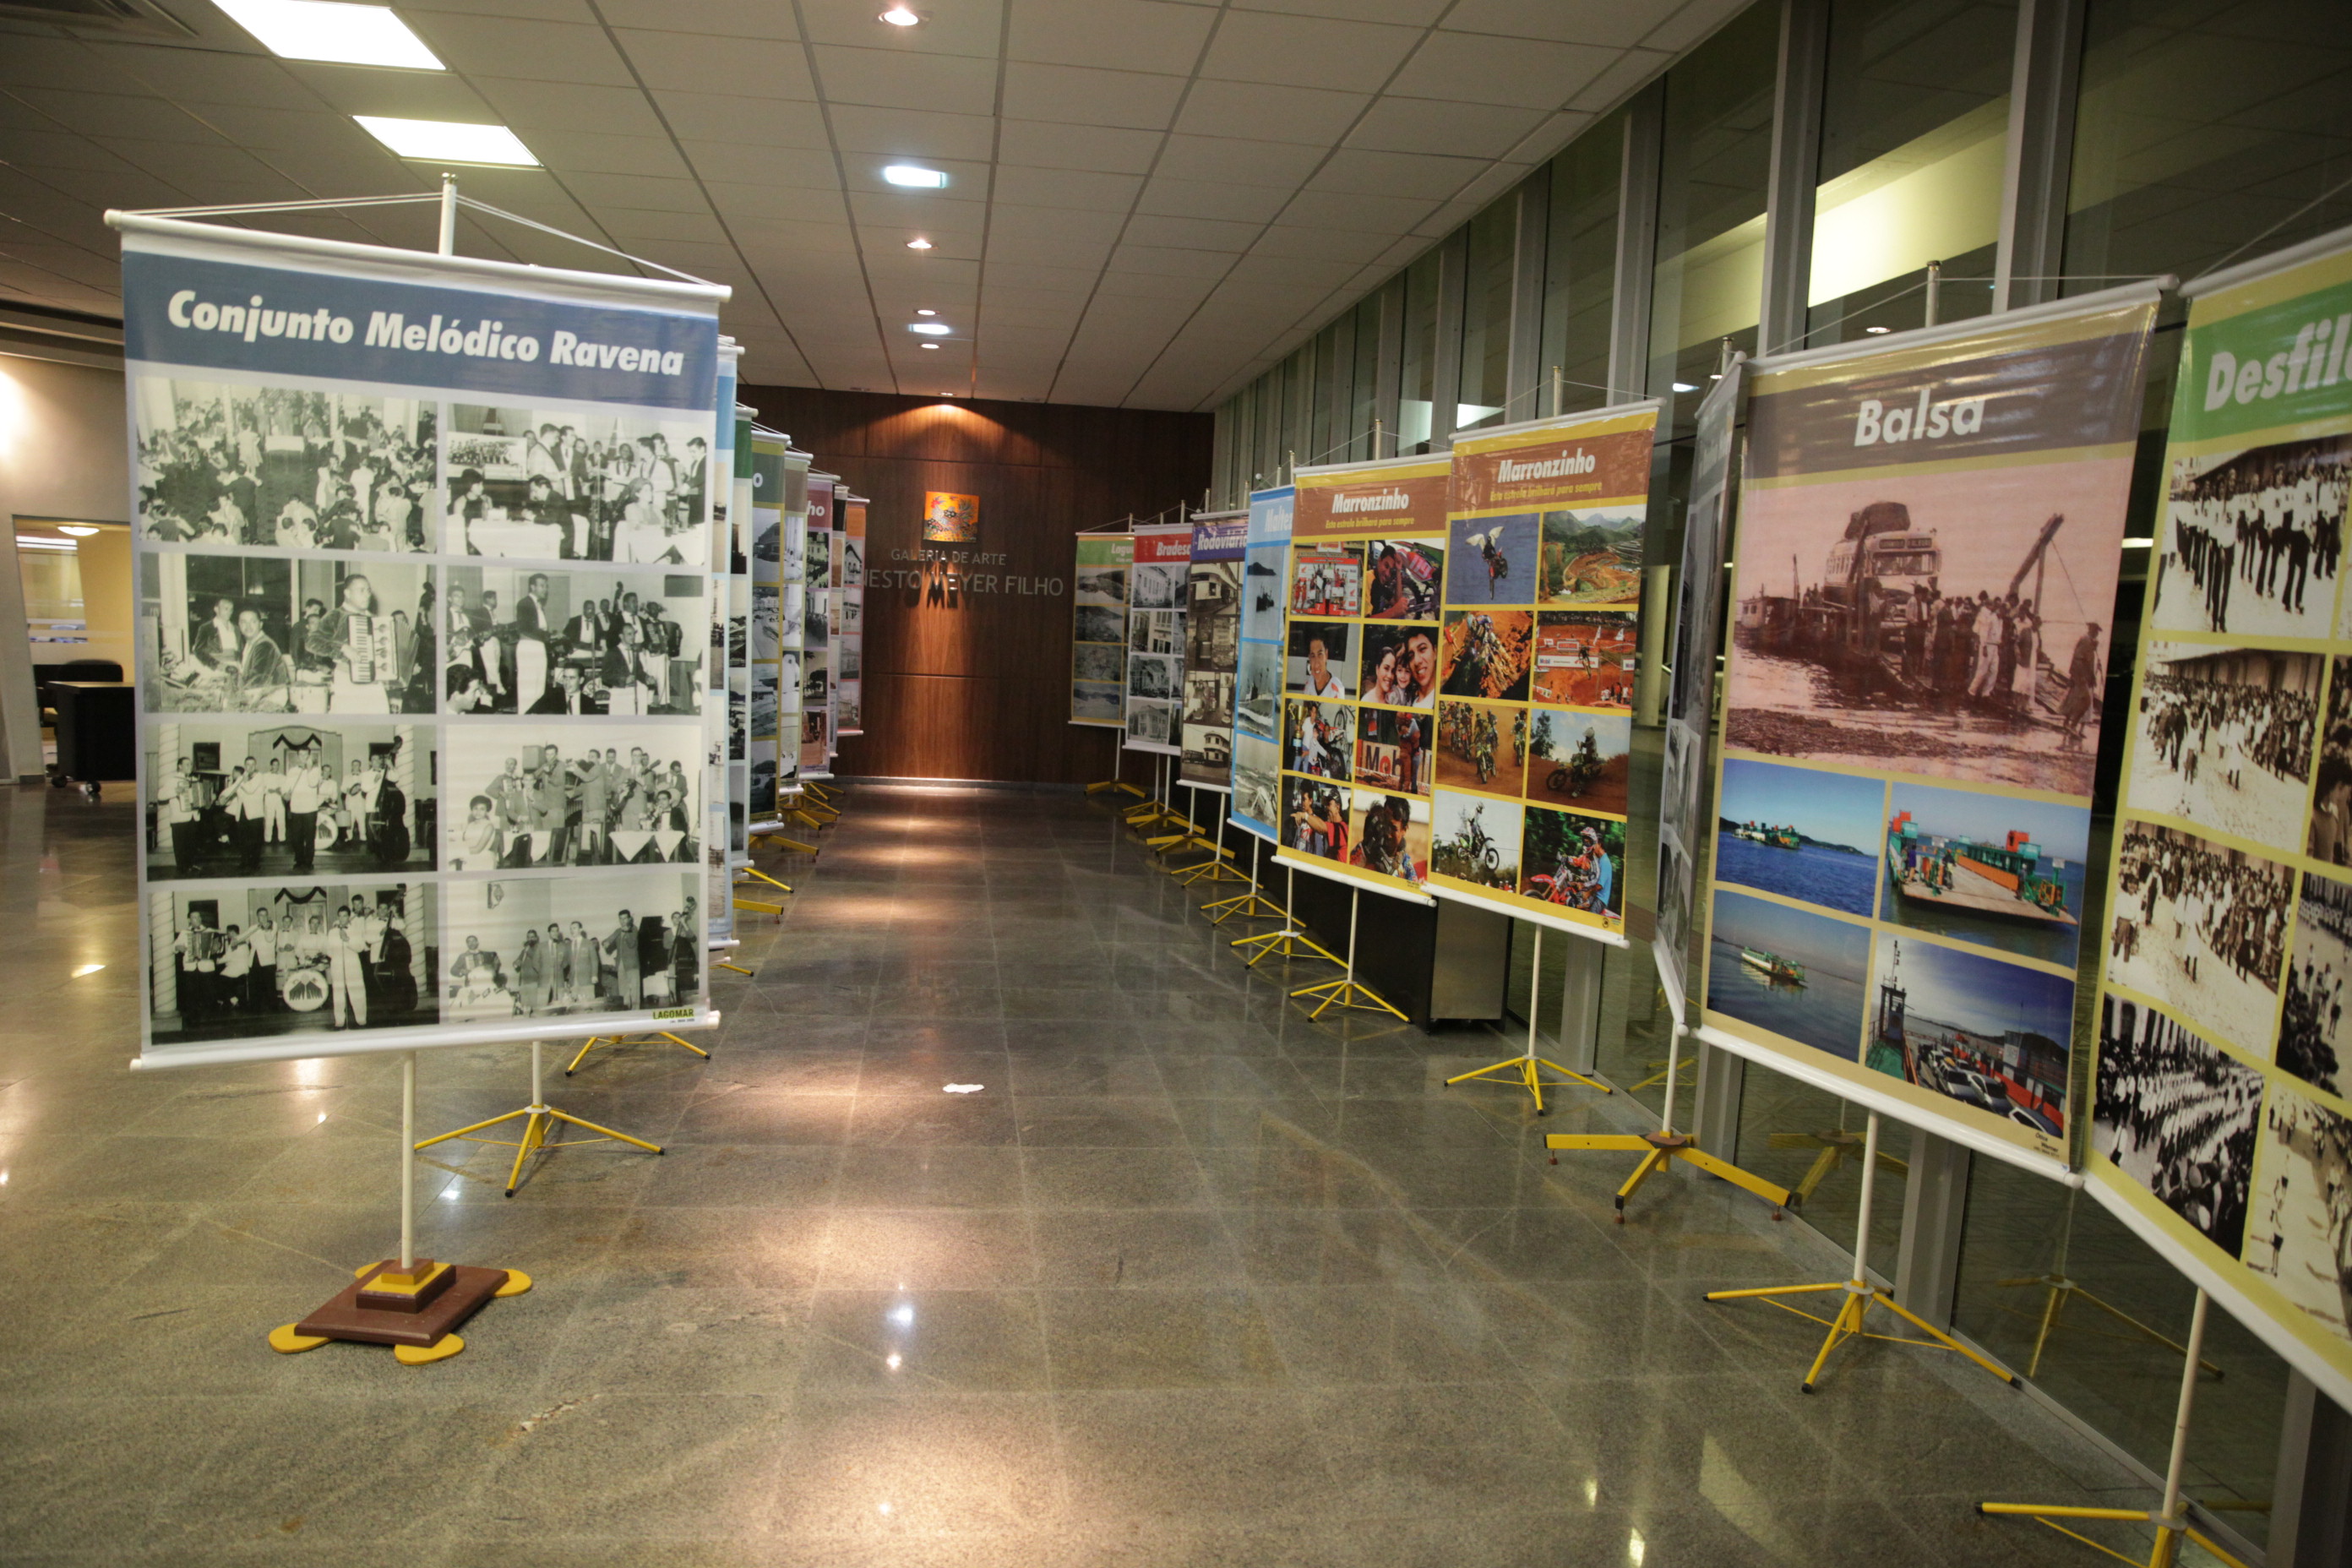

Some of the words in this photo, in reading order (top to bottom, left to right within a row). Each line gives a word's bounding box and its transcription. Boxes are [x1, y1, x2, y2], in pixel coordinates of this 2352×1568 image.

[169, 289, 354, 342] Conjunto
[364, 310, 540, 362] Melódico
[550, 331, 684, 376] Ravena
[2203, 313, 2352, 411] Desfil
[1854, 388, 1985, 447] Balsa
[1497, 448, 1596, 483] Marronzinho
[1331, 487, 1409, 514] Marronzinho
[890, 548, 948, 563] GALERIA
[952, 551, 970, 564] DE
[972, 553, 1007, 565] ARTE
[1111, 543, 1135, 557] Lagu
[928, 571, 999, 594] MEYER
[1004, 575, 1064, 596] FILHO
[653, 1009, 694, 1020] LAGOMAR
